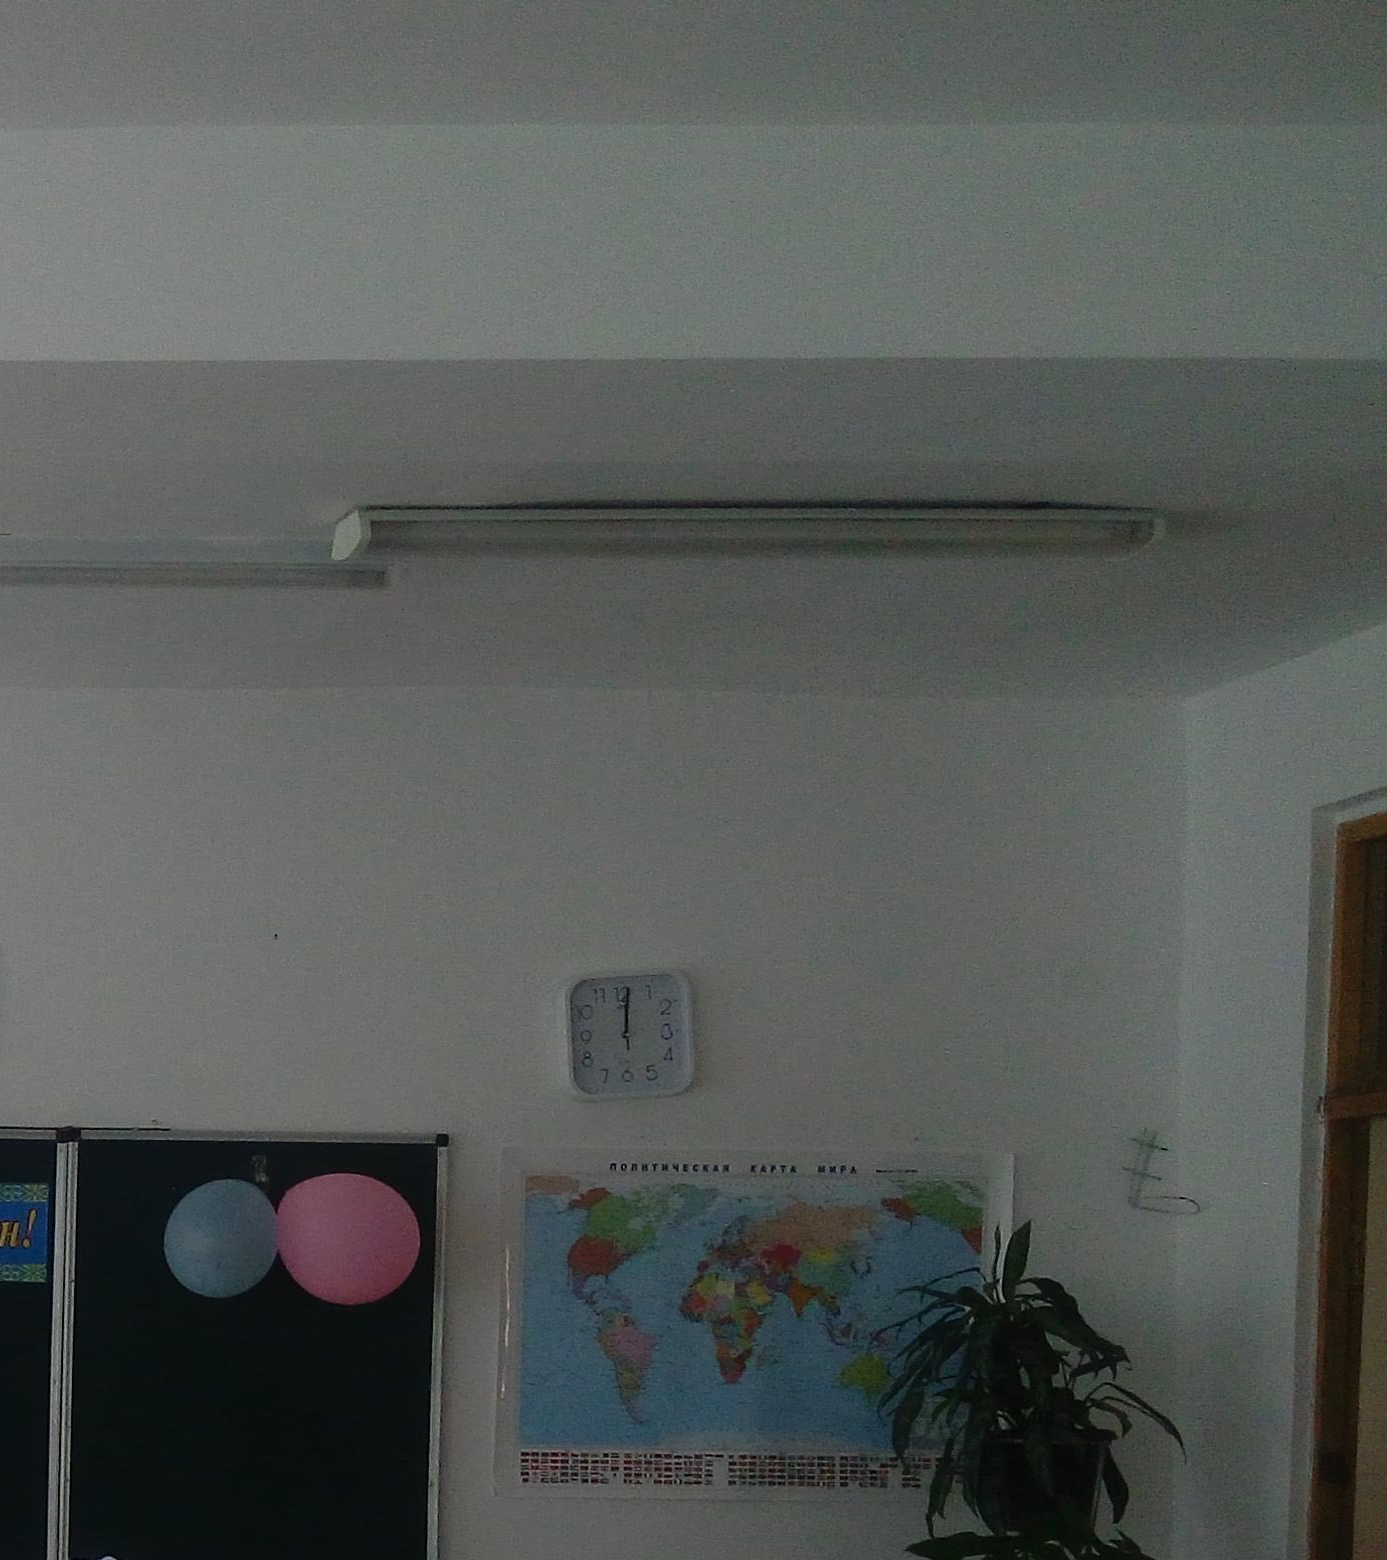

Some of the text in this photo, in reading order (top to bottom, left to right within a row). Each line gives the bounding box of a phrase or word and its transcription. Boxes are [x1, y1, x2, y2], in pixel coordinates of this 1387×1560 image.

[581, 1050, 594, 1068] 8
[662, 1046, 674, 1061] 4
[645, 1063, 658, 1081] 5
[609, 1162, 858, 1175] ПОЛИТИЧЕСКАЯ КАРТА МИРА
